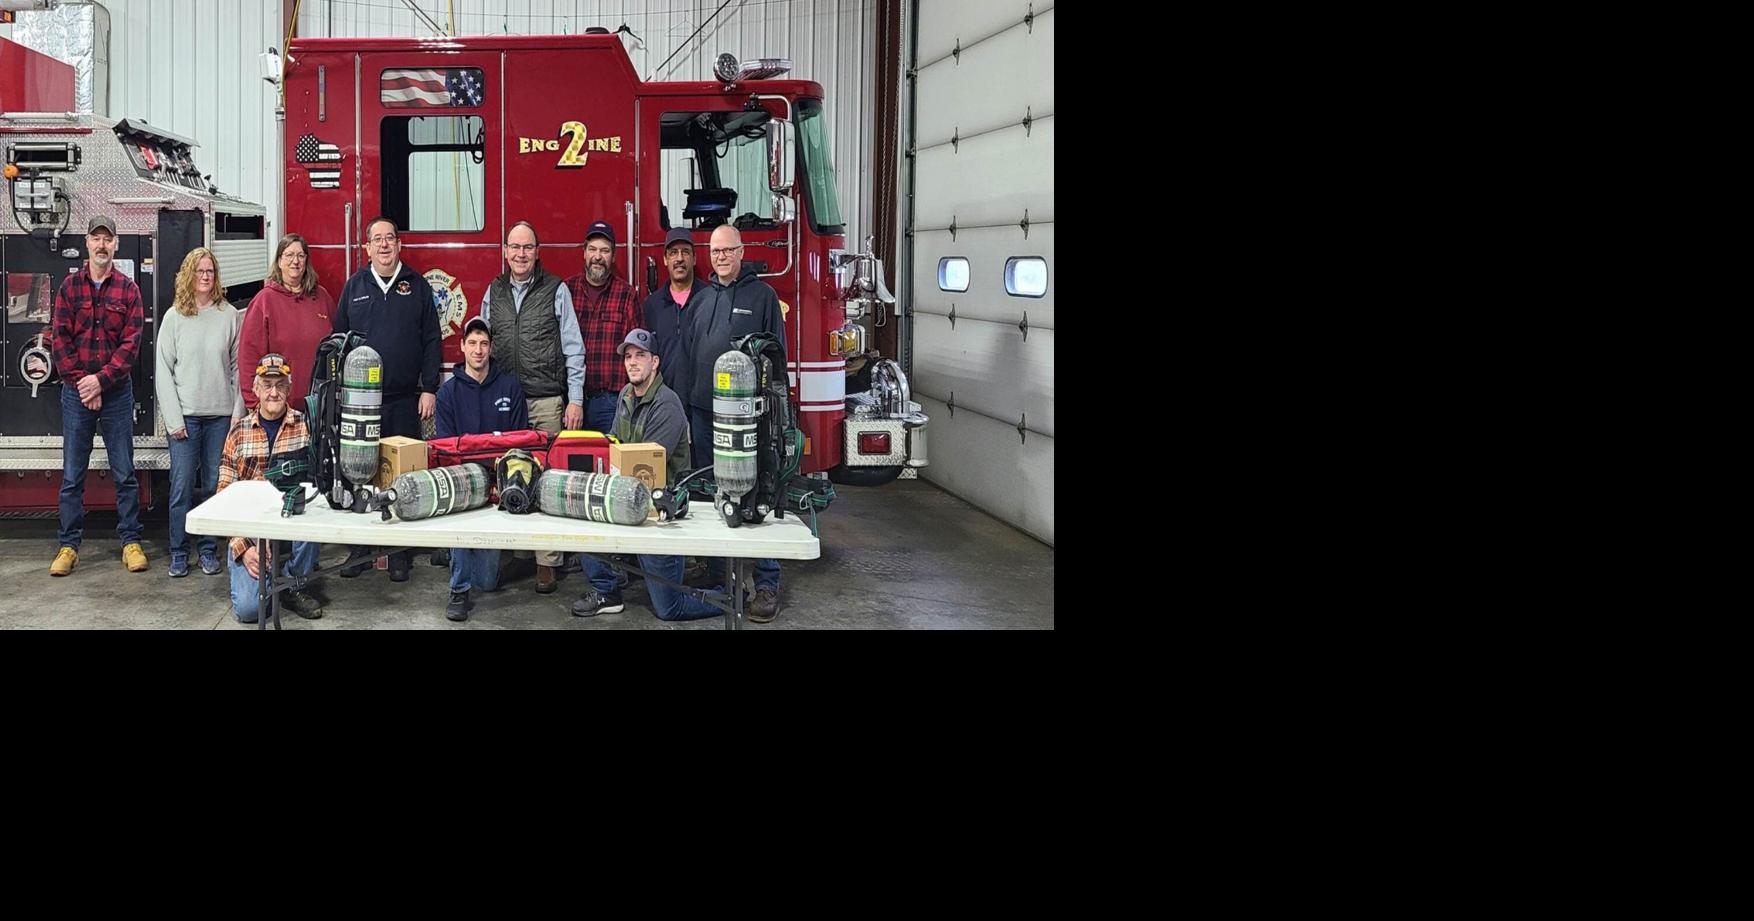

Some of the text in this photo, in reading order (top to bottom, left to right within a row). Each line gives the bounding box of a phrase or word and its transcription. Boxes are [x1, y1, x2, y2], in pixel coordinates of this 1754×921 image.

[435, 274, 450, 284] RIVER
[455, 294, 463, 318] EMS
[341, 424, 354, 435] SA
[368, 425, 380, 436] MS
[714, 433, 731, 447] SA
[745, 434, 757, 446] MS
[434, 471, 448, 497] MSA
[594, 474, 604, 492] MS
[594, 508, 606, 521] SA
